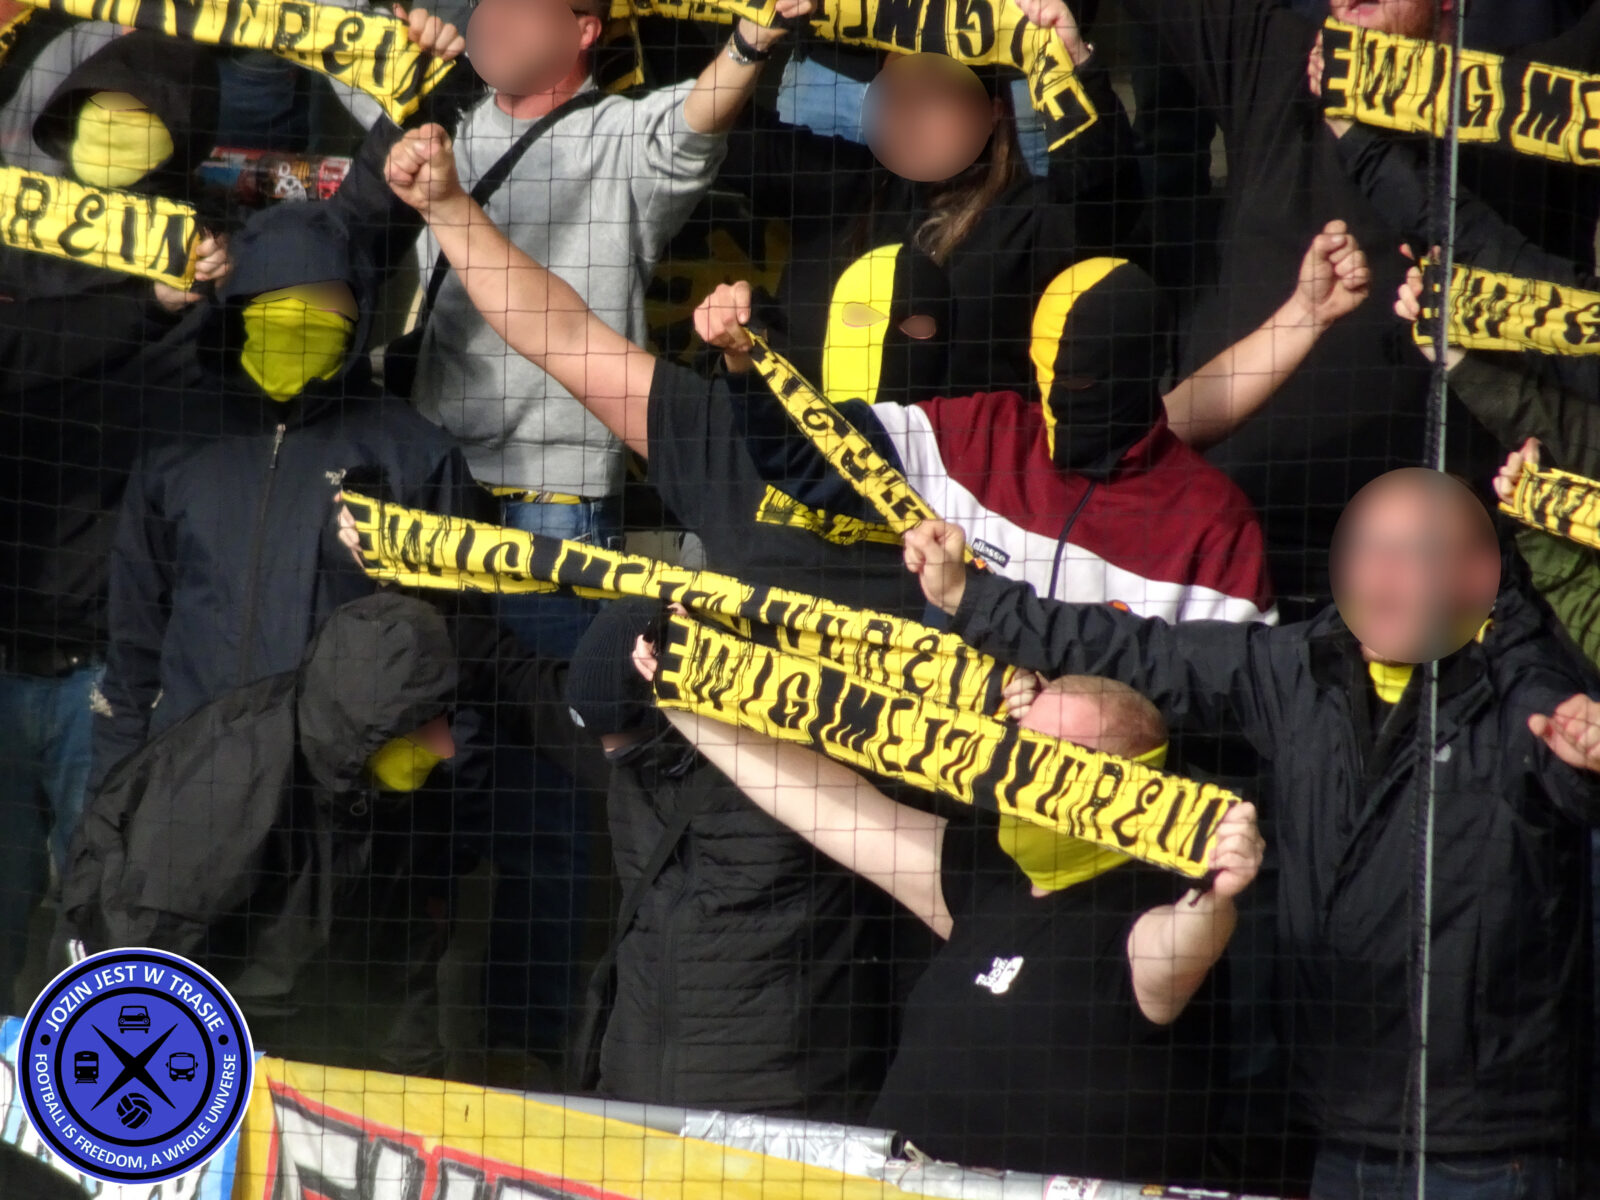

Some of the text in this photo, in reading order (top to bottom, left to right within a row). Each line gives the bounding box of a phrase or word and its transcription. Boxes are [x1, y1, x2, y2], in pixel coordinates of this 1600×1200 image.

[1322, 27, 1495, 129] EWIG
[655, 613, 812, 729] EWIG
[1003, 738, 1238, 864] VEREIN
